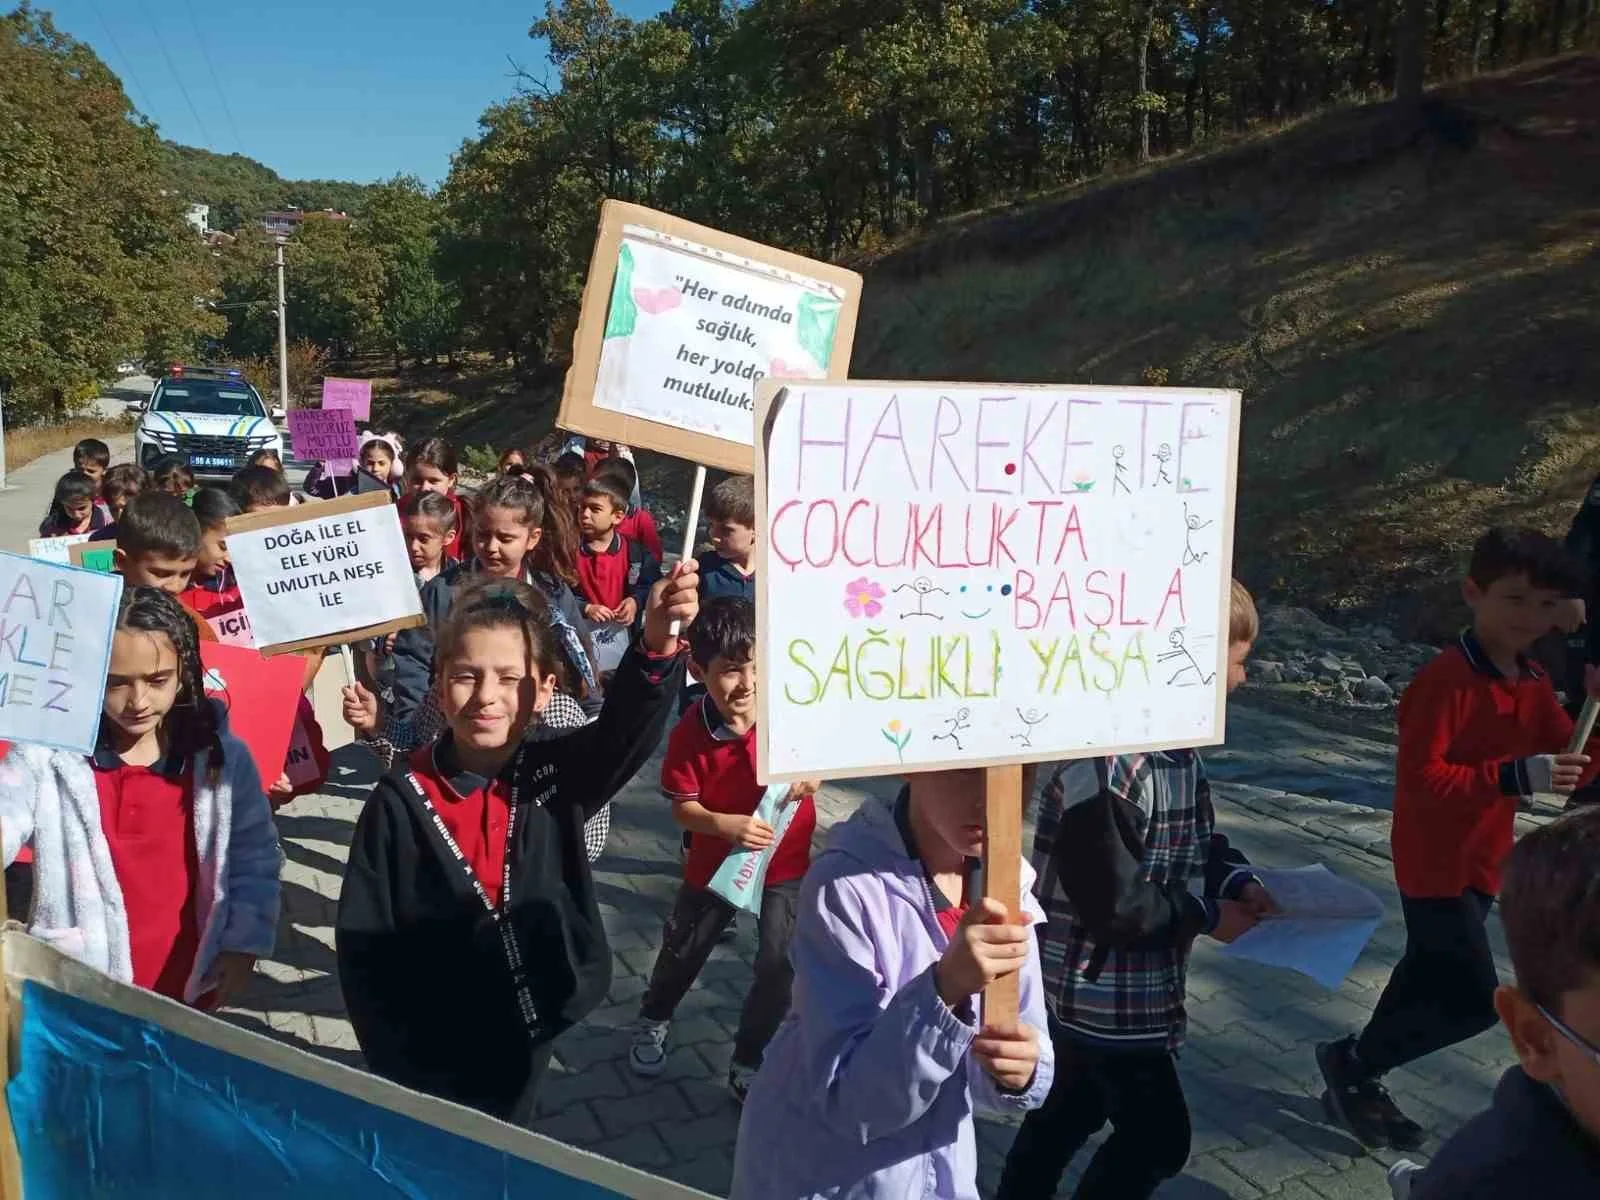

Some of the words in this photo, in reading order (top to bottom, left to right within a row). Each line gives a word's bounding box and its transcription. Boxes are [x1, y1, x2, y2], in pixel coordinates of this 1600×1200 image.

[675, 275, 718, 302] "Her
[721, 292, 793, 325] adımda
[696, 316, 758, 348] sağlık,
[676, 344, 710, 367] her
[713, 355, 765, 381] yolda
[306, 433, 352, 447] MUTLU
[264, 527, 317, 550] DOĞA
[320, 525, 343, 540] İLE
[348, 519, 367, 535] EL
[769, 497, 1089, 572] ÇOCUKLUKTA
[280, 553, 310, 571] ELE
[313, 541, 360, 564] YÜRÜ
[266, 569, 341, 596] UMUTLA
[344, 560, 385, 581] NEŞE
[319, 591, 345, 608] İLE
[218, 611, 251, 636] İÇİ
[784, 627, 1002, 705] SAĞLIKLI
